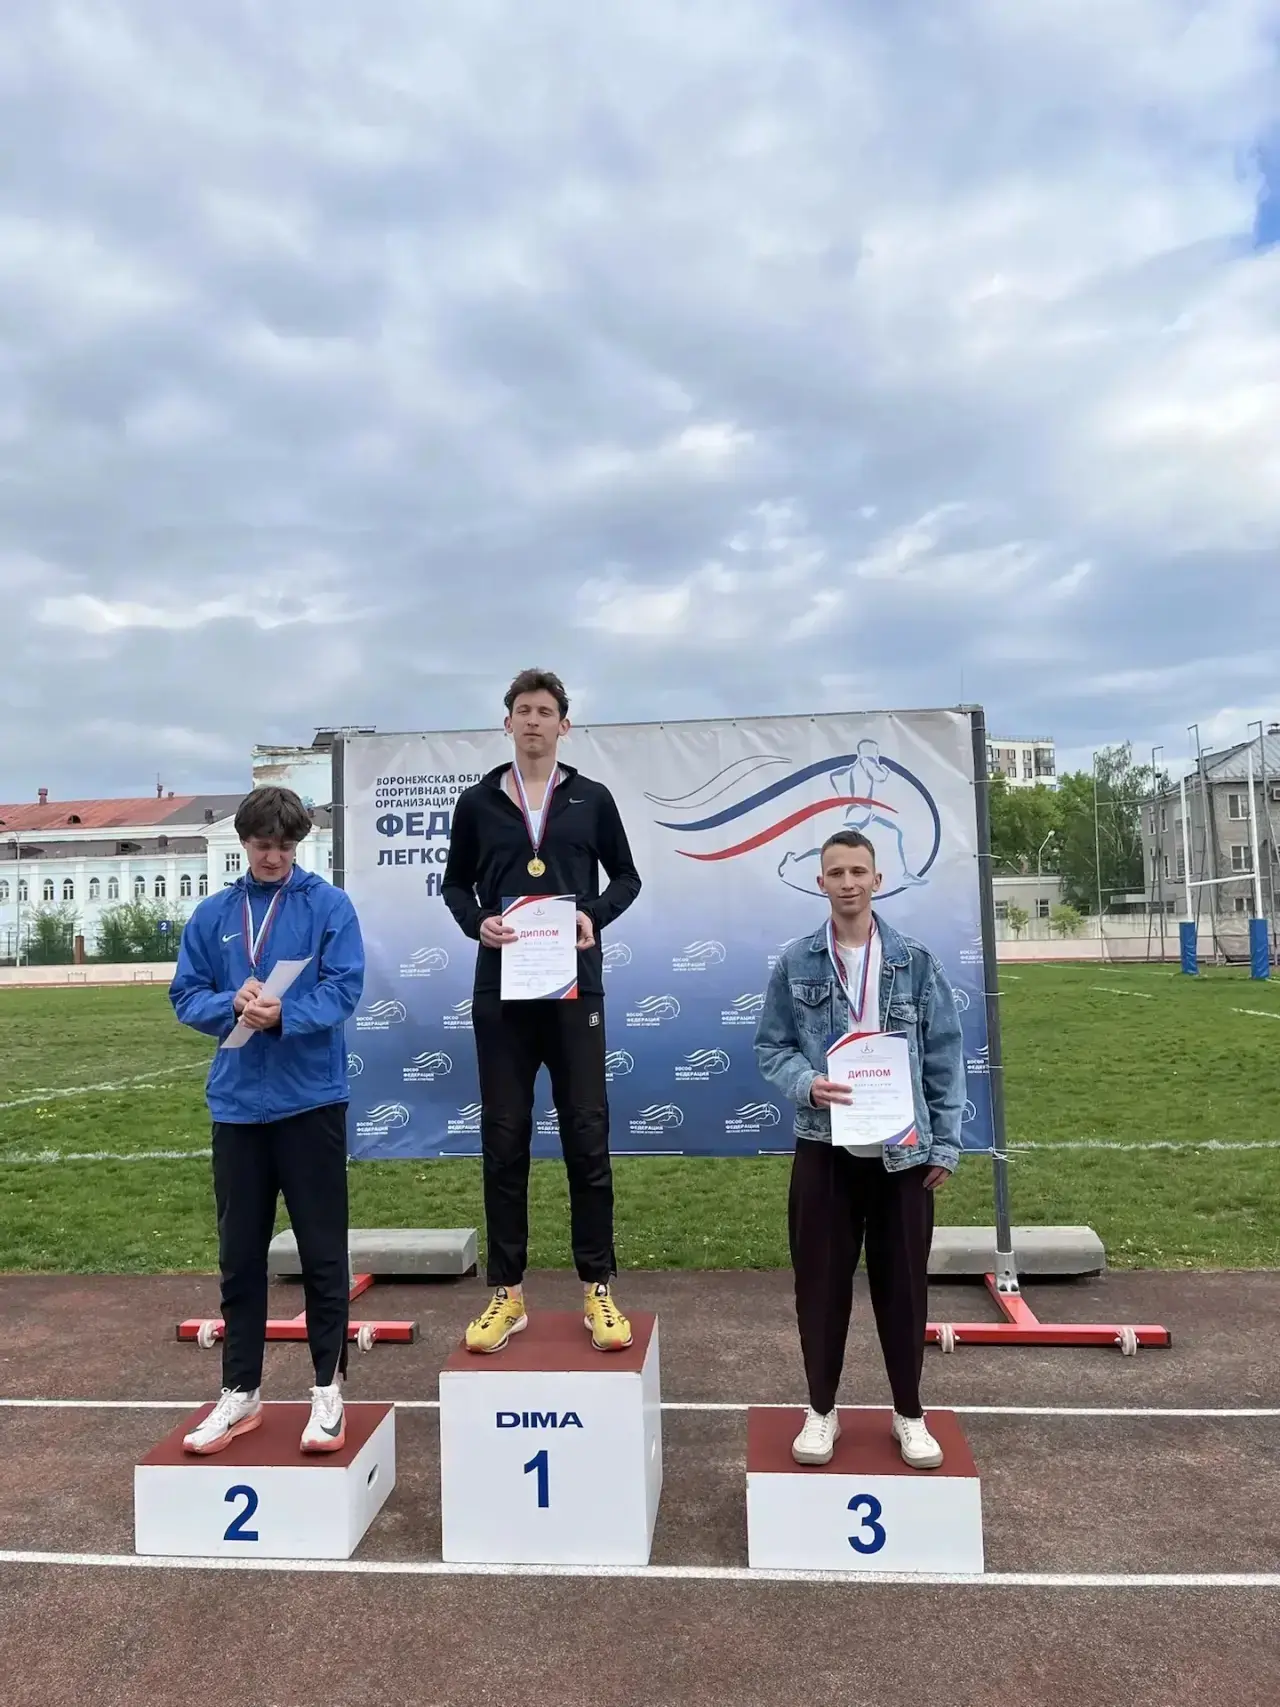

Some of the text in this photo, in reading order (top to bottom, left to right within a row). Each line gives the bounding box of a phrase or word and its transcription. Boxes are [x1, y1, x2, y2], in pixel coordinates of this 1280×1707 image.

[377, 775, 455, 785] ВОРОНЕЖСКАЯ
[375, 786, 446, 796] СПОРТИВНАЯ
[375, 797, 455, 808] ОРГАНИЗАЦИЯ
[160, 922, 167, 930] 2
[520, 929, 559, 939] ДИПЛОМ
[848, 1068, 891, 1079] ДИПЛОМ
[496, 1411, 583, 1428] DIMA
[523, 1450, 550, 1508] 1
[223, 1484, 259, 1541] 2
[847, 1493, 886, 1555] 3
